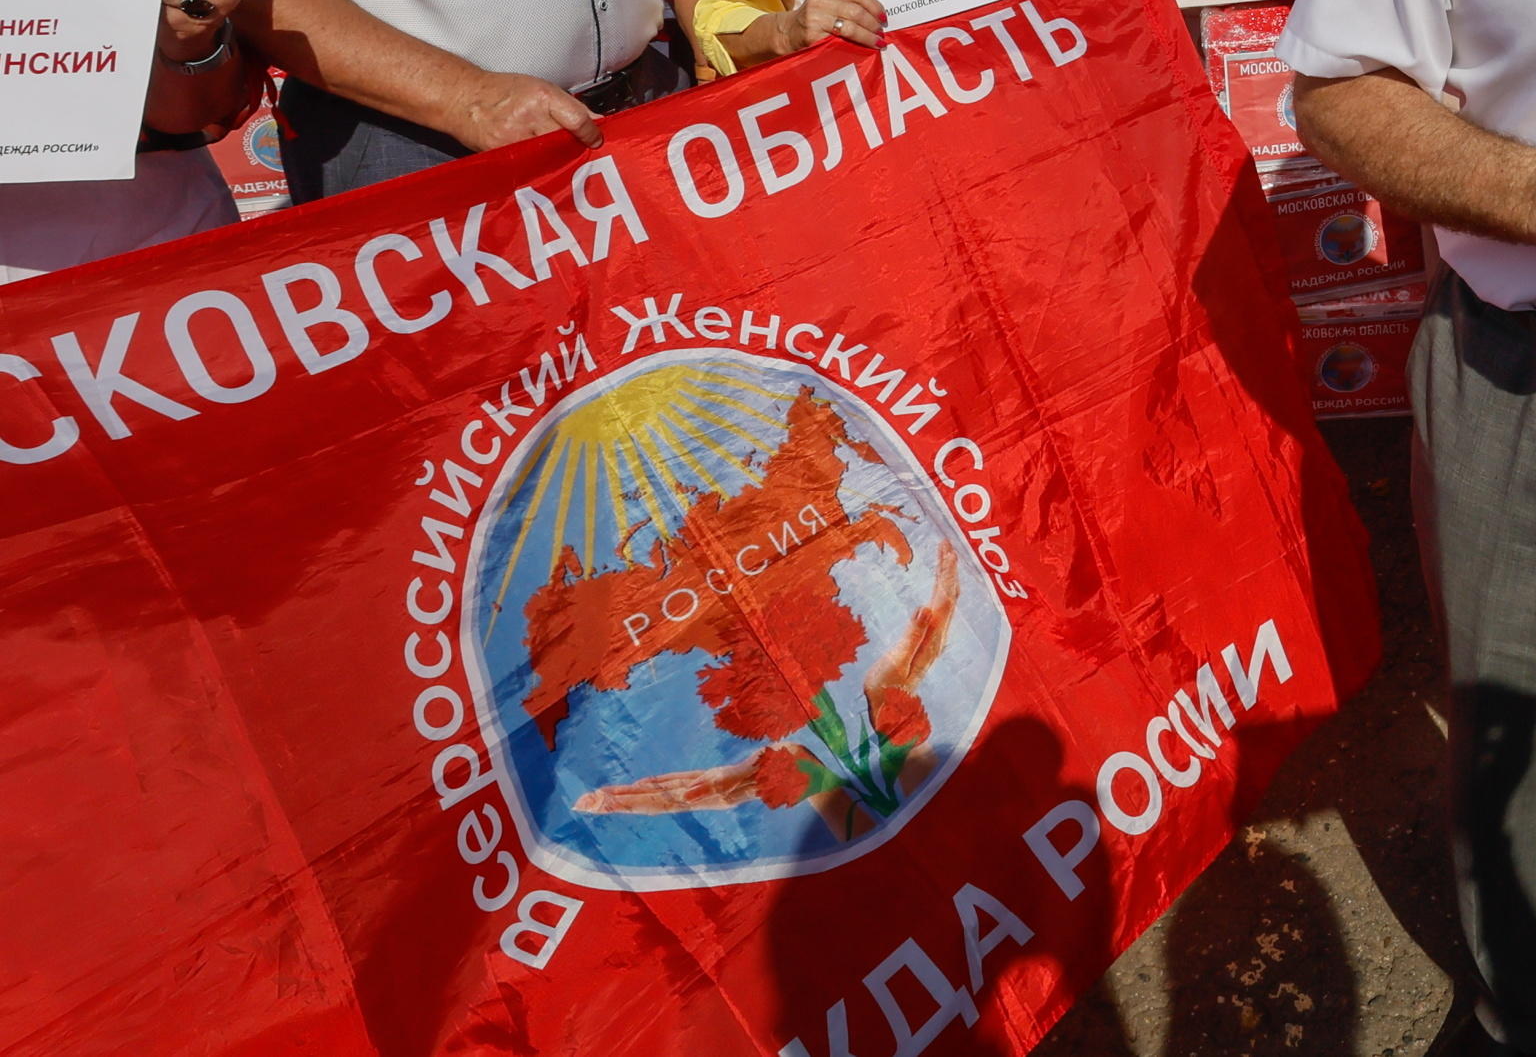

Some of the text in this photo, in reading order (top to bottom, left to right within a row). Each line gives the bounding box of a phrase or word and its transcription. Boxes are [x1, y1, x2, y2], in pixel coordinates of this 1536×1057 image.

[667, 0, 1088, 221] ОБЛАСТЬ
[42, 143, 99, 154] РОССИИ»
[1252, 143, 1305, 155] НАДЕЖ
[1278, 191, 1354, 215] МОСКОВСКАЯ
[1292, 260, 1406, 288] НАДЕЖДА РОССИИ
[1302, 322, 1410, 339] КОВСКАЯ ОБЛАСТЬ
[1356, 396, 1405, 407] РОССИИ
[621, 501, 829, 647] РОССИЯ
[404, 291, 1028, 970] Всероссийский Женский Союз
